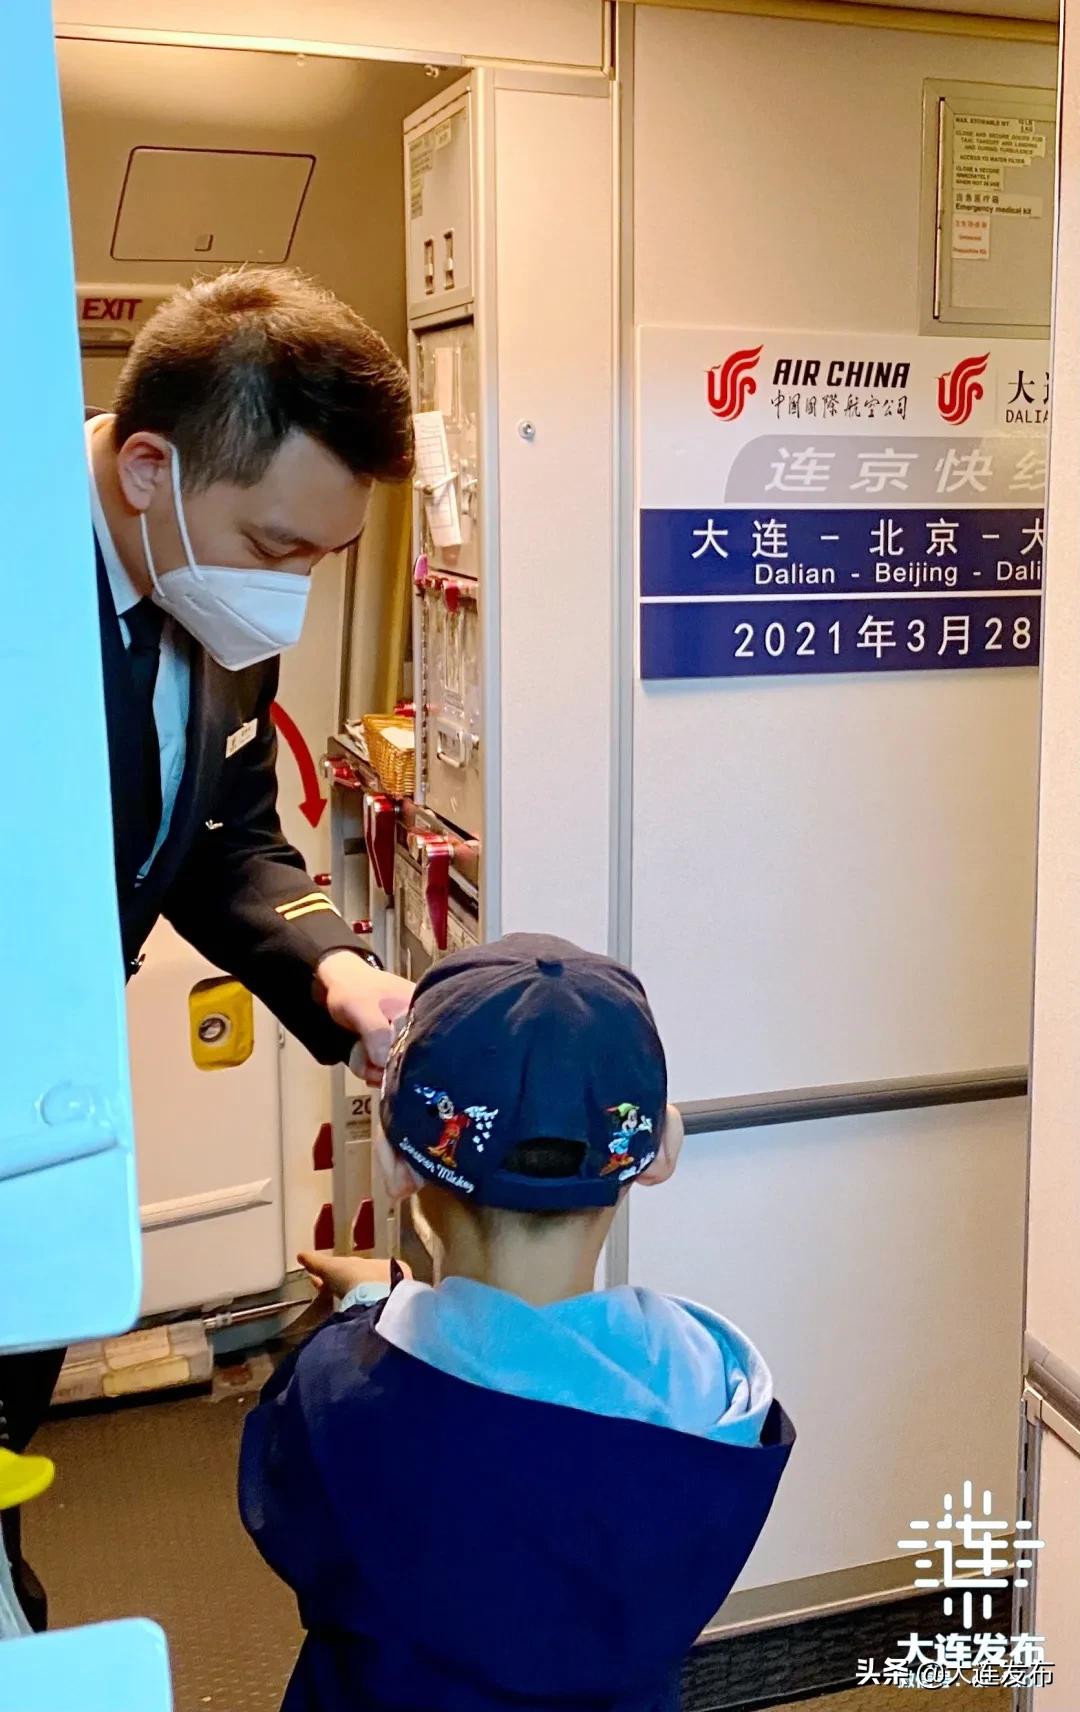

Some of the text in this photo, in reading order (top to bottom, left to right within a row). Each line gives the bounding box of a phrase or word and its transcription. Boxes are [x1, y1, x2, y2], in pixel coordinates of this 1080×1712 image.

[956, 203, 994, 213] Emergency
[82, 298, 143, 320] EXIT
[772, 359, 911, 388] AIR CHINA
[755, 563, 835, 585] Dalian
[875, 561, 958, 587] Beijing
